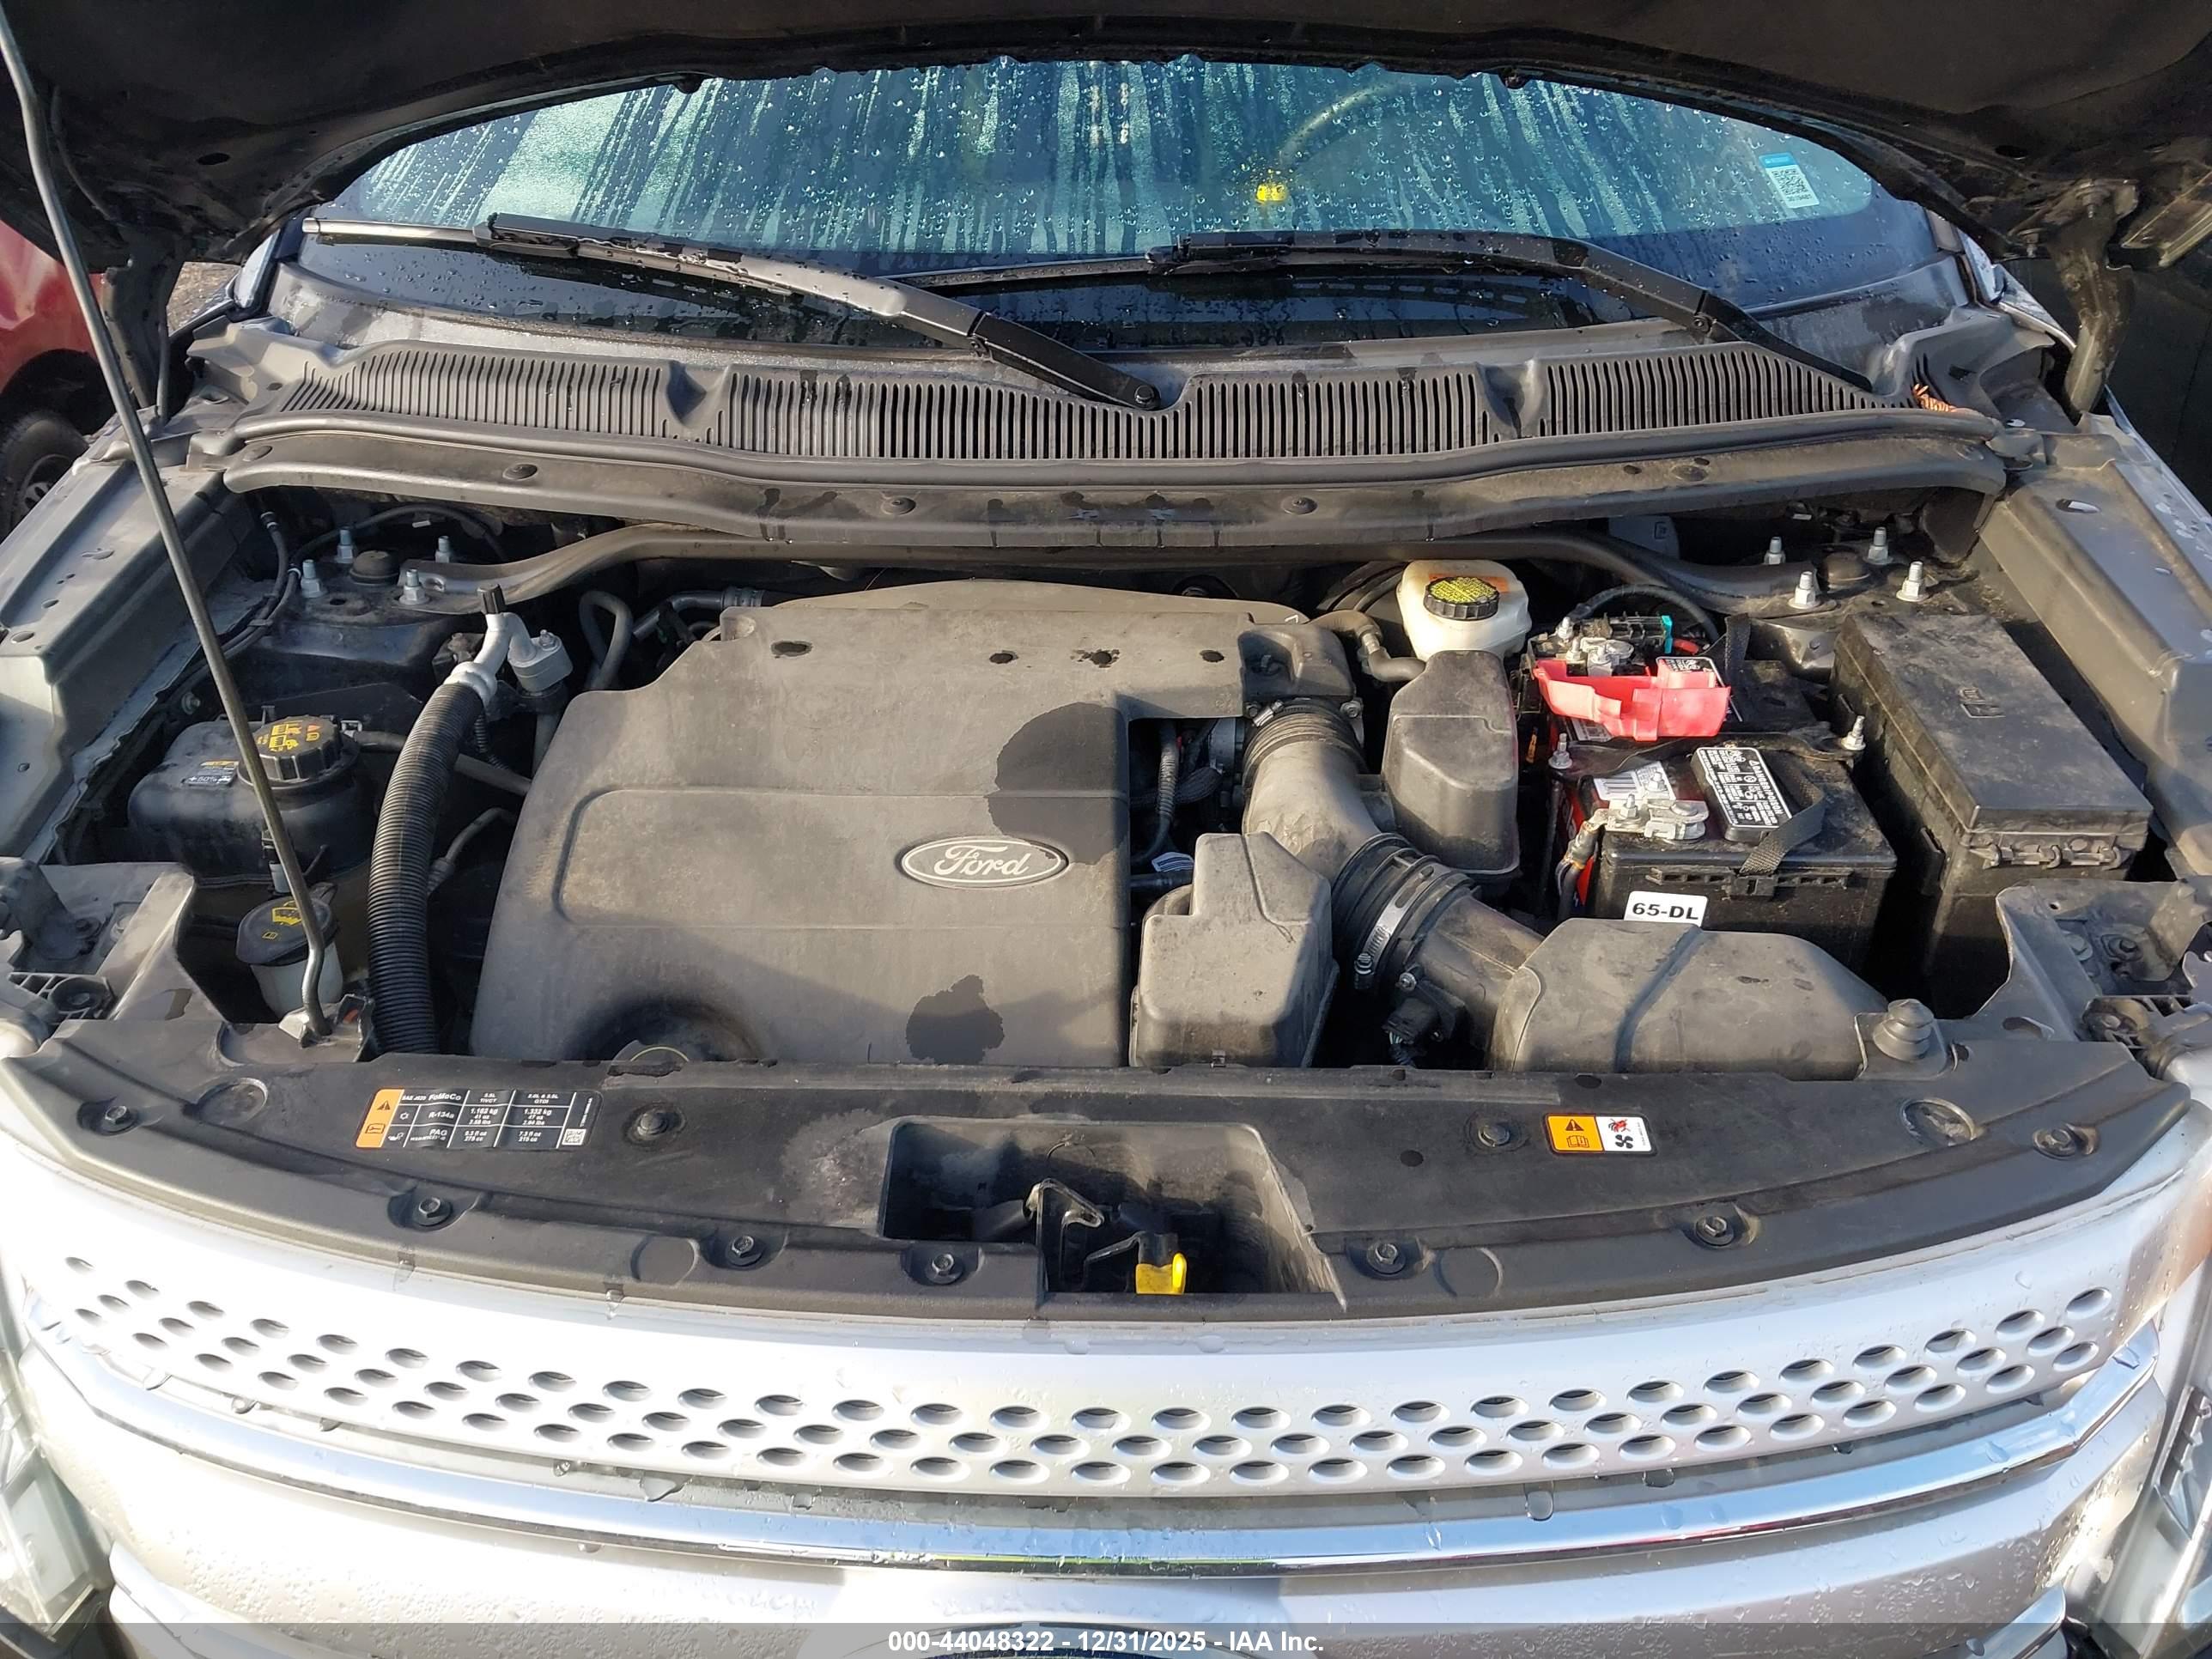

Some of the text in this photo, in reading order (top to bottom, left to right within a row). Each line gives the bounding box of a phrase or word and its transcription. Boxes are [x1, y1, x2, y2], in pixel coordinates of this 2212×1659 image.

[933, 845, 1031, 876] Ford
[1632, 902, 1698, 920] 65-DL
[428, 1092, 462, 1101] FoMoCo
[428, 1110, 455, 1119] R-134a
